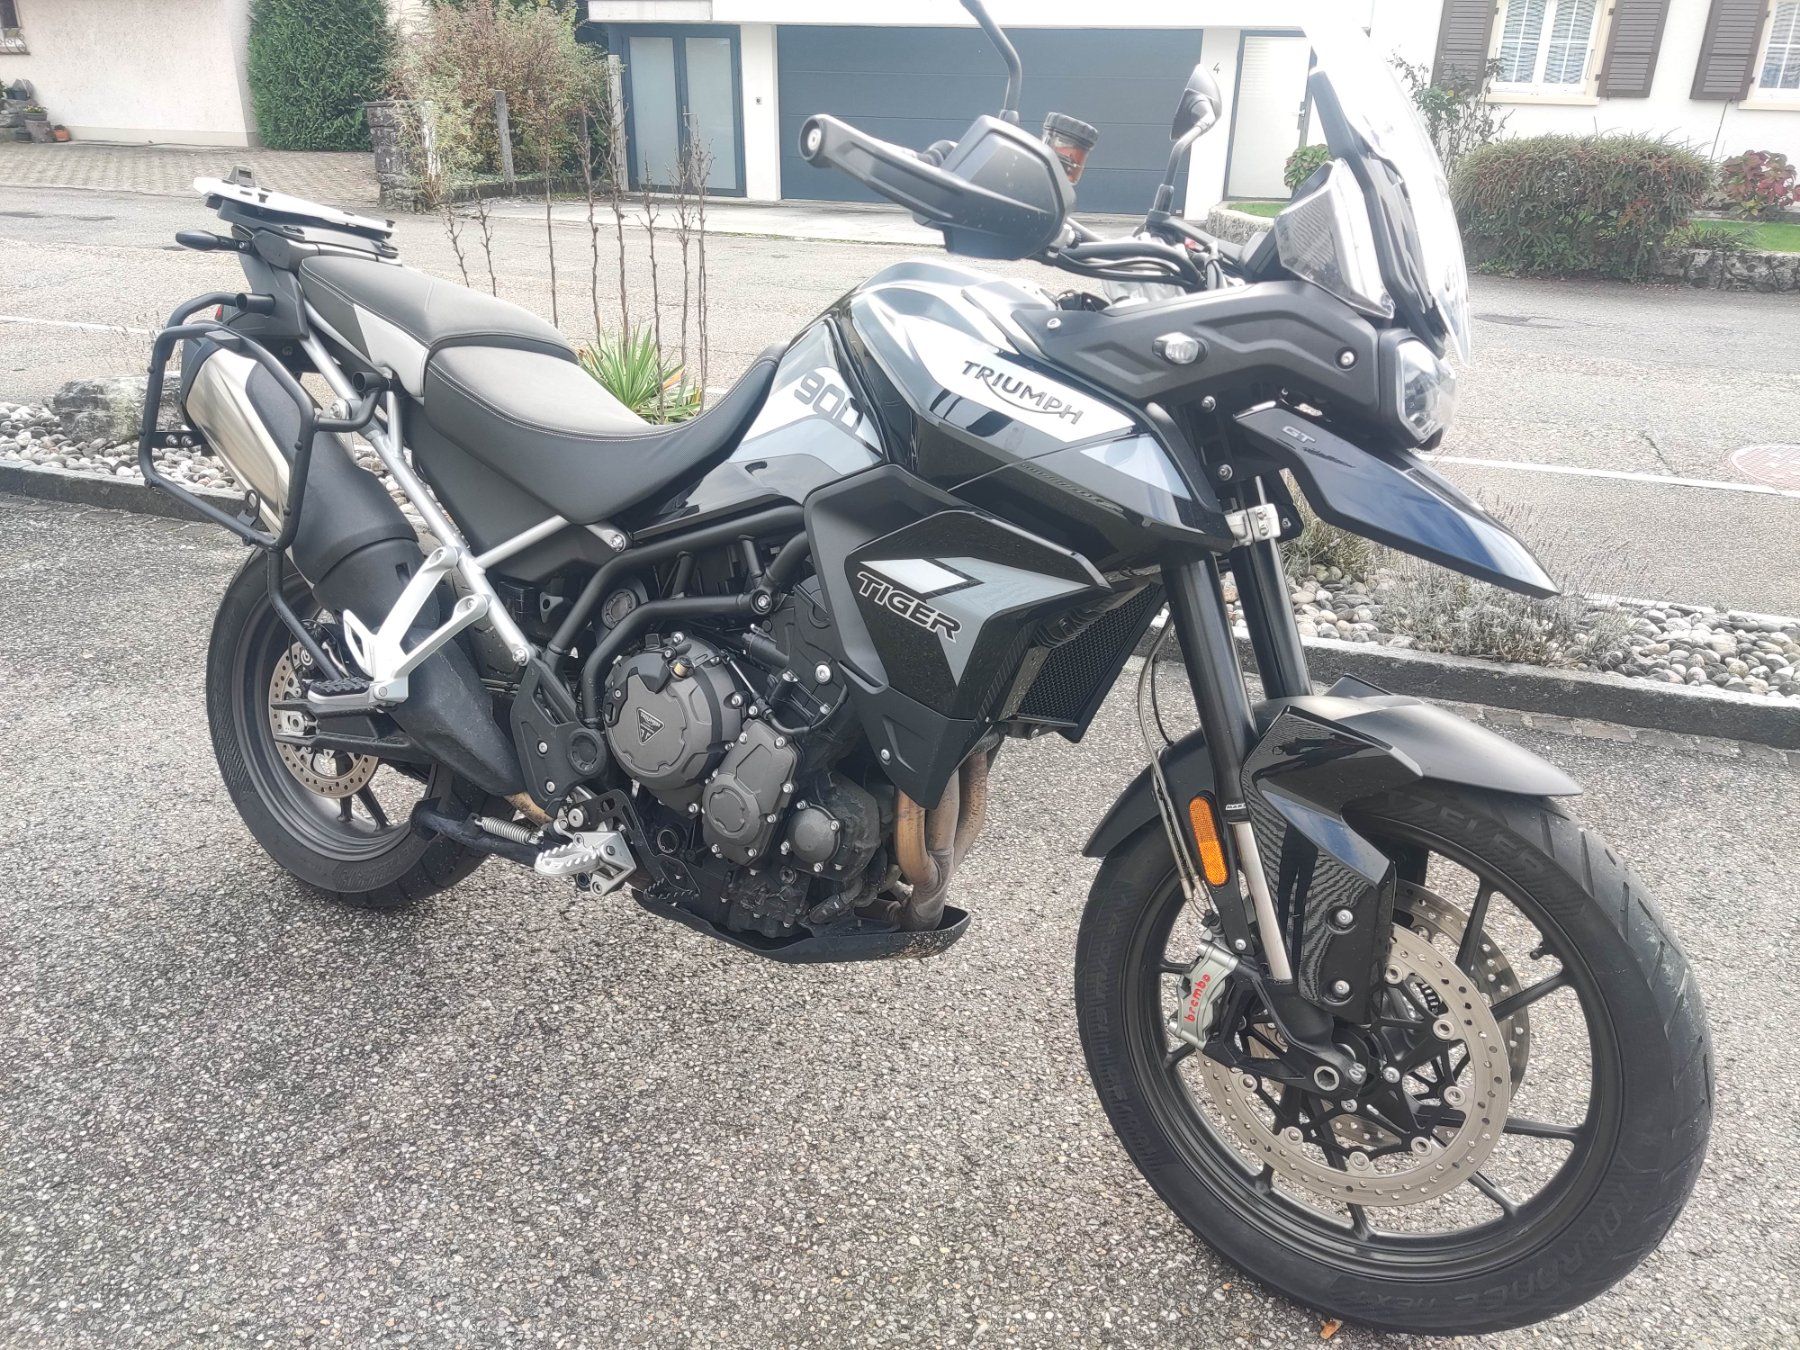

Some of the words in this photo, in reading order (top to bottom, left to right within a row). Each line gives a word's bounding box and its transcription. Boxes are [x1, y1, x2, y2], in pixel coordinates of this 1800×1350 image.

[1213, 62, 1220, 75] 4
[794, 370, 864, 436] 900
[961, 359, 1085, 425] TRIUMPH
[1282, 425, 1316, 443] GT
[856, 571, 962, 643] TIGER
[1183, 974, 1211, 1022] brembo
